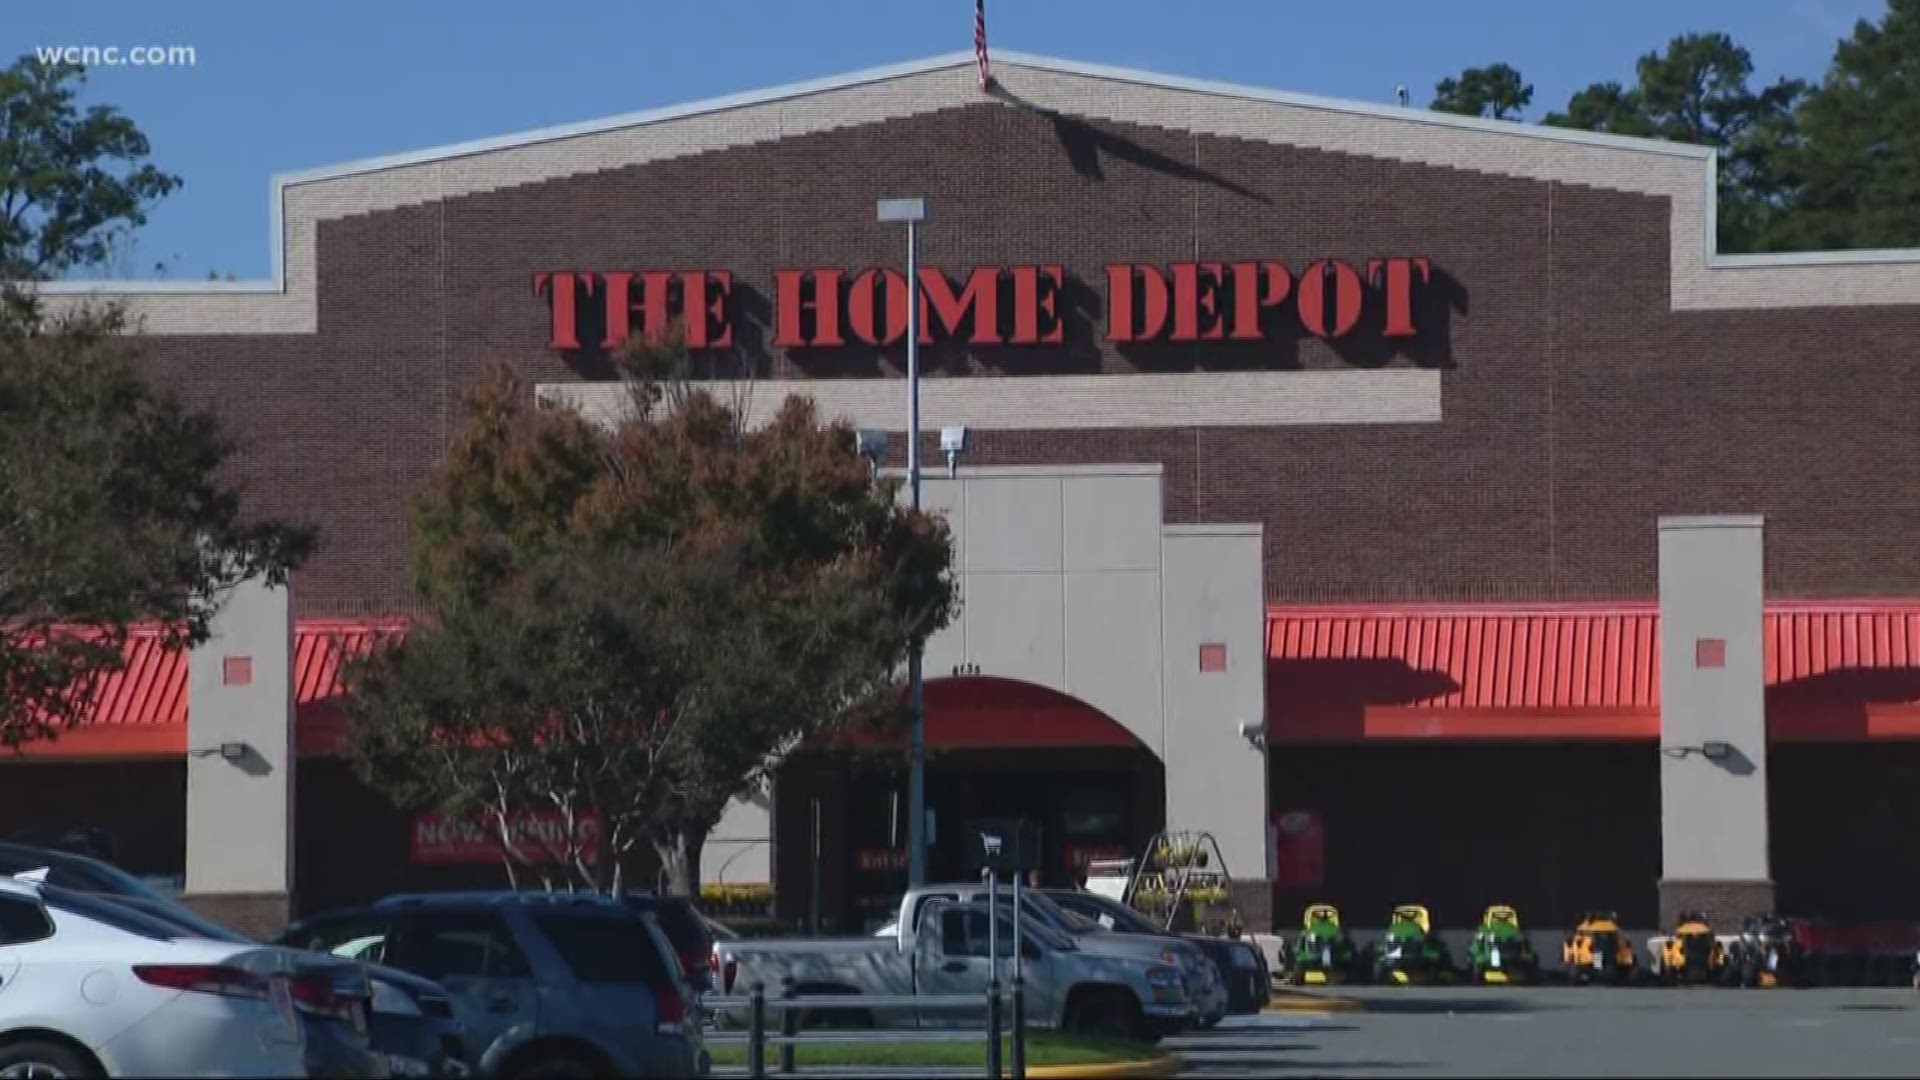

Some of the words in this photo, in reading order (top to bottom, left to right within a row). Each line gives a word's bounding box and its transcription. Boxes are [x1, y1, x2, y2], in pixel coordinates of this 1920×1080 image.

[533, 269, 733, 349] THE
[773, 264, 1065, 346] HOME
[1103, 256, 1431, 342] DEPOT
